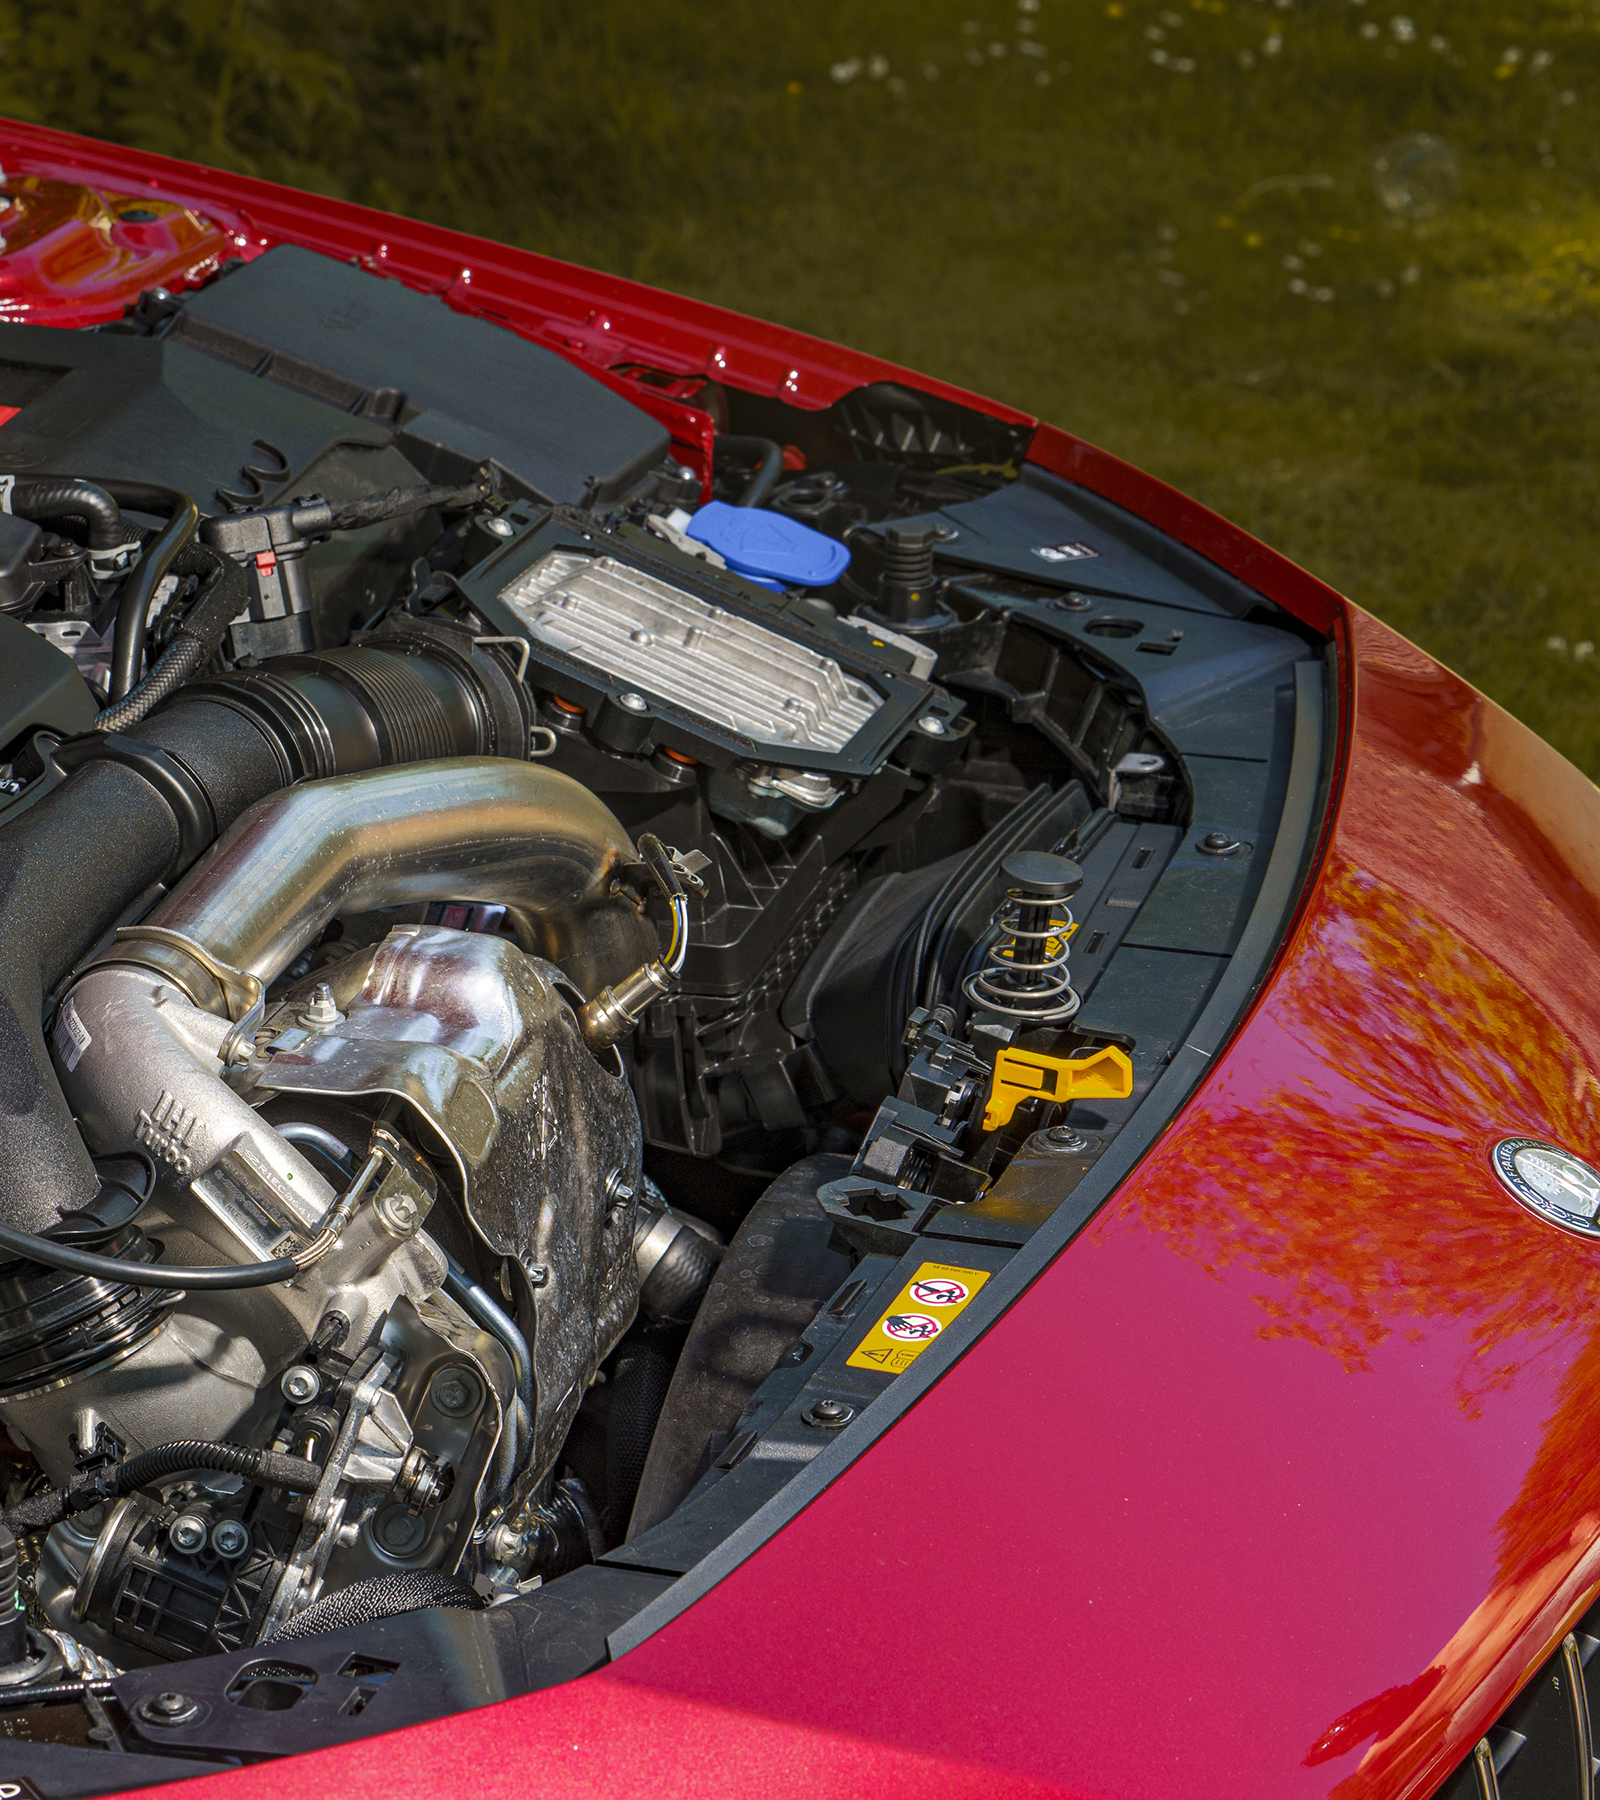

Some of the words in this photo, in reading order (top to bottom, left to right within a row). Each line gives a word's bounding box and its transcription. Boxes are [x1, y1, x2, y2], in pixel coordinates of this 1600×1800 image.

[134, 1108, 191, 1175] Turbo
[151, 1090, 200, 1149] IHI
[224, 1203, 242, 1220] MADE
[240, 1219, 251, 1230] IN
[248, 1227, 270, 1249] ITALY
